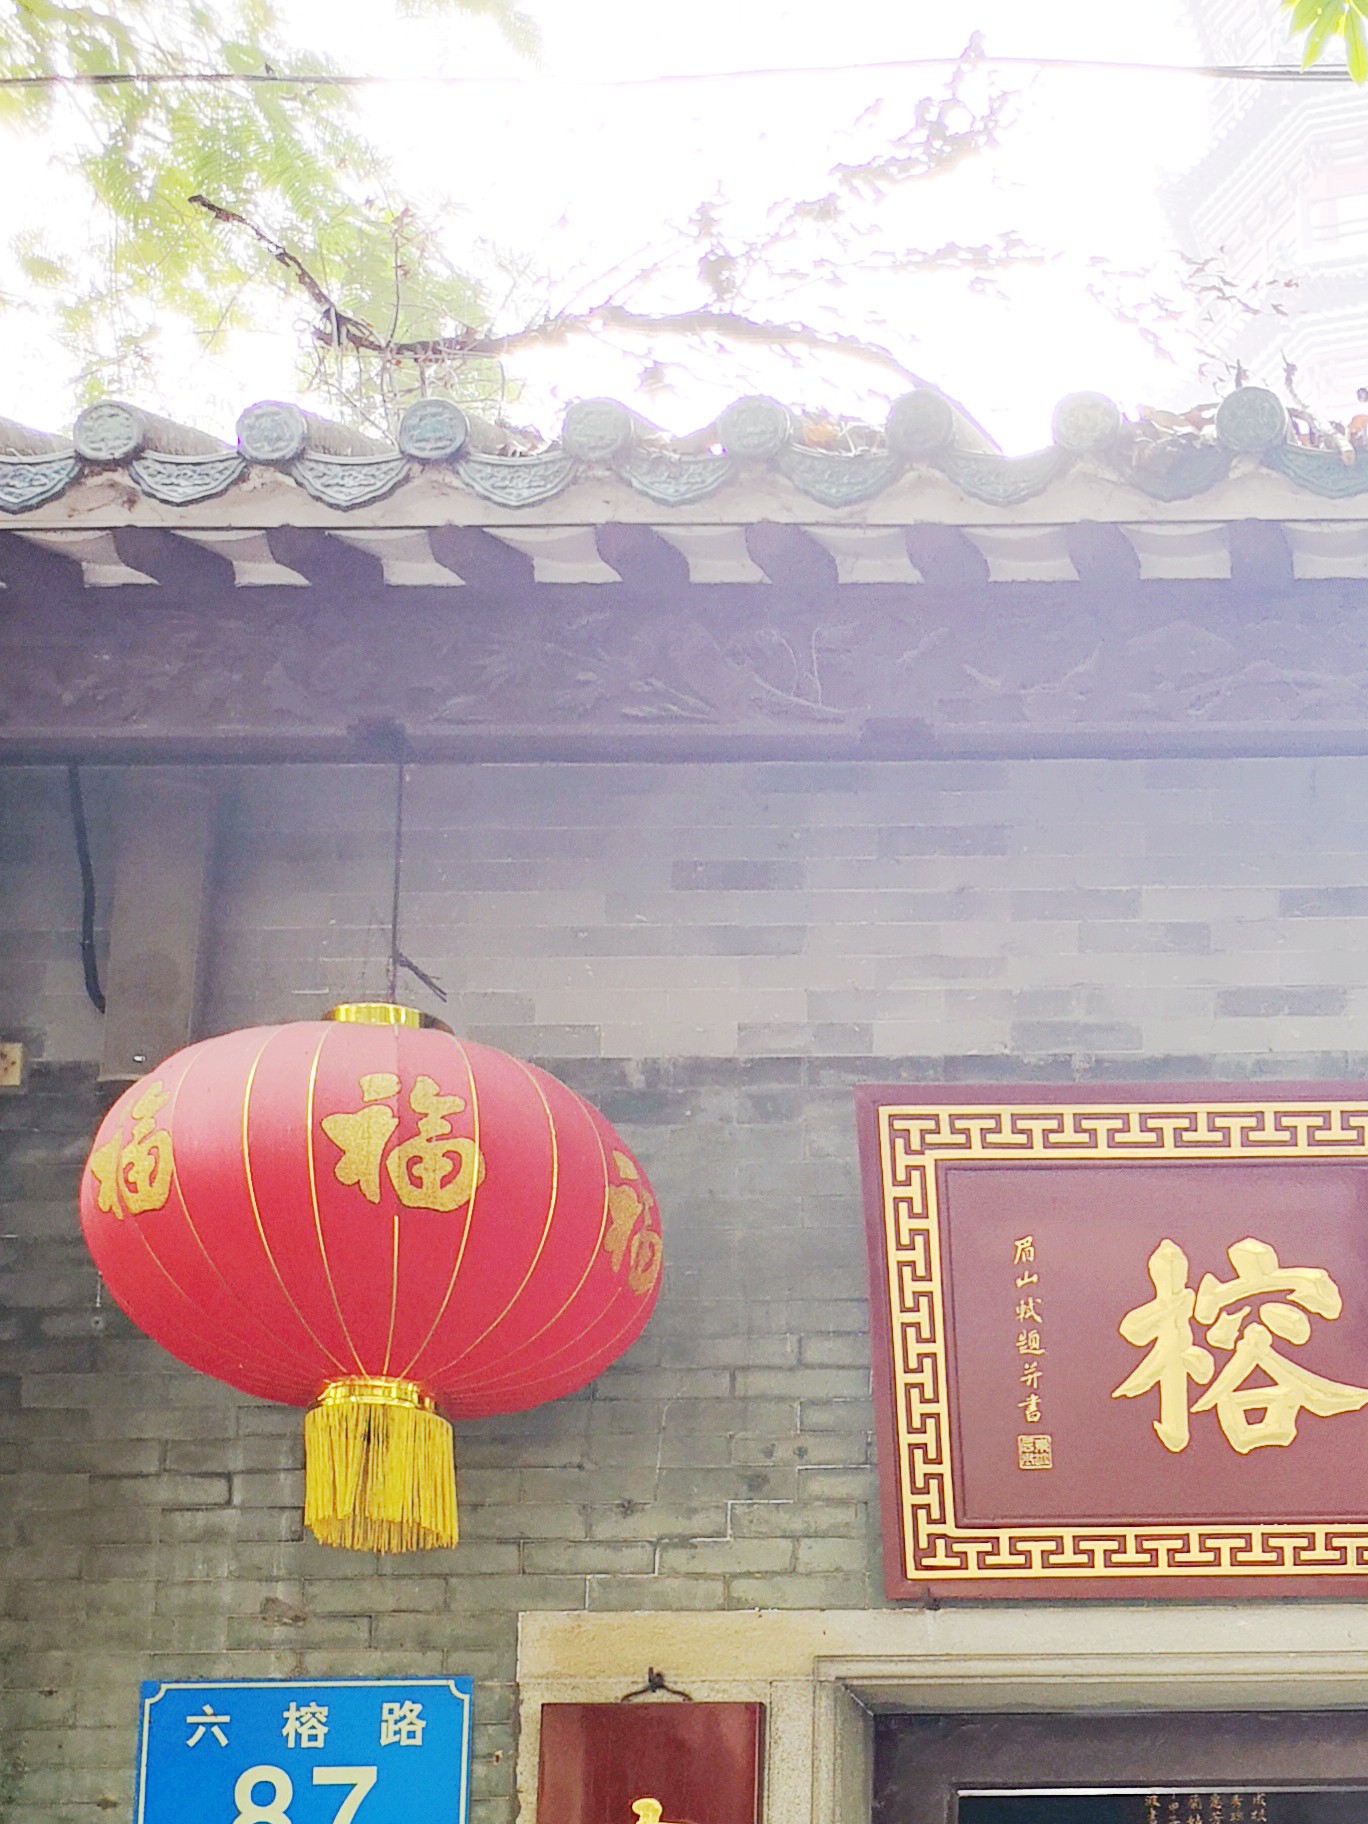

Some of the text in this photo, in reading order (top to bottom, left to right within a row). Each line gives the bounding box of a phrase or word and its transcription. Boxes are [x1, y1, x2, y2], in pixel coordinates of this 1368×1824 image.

[91, 1080, 175, 1220] 福
[321, 1072, 486, 1213] 福
[186, 1700, 426, 1749] 六榕路
